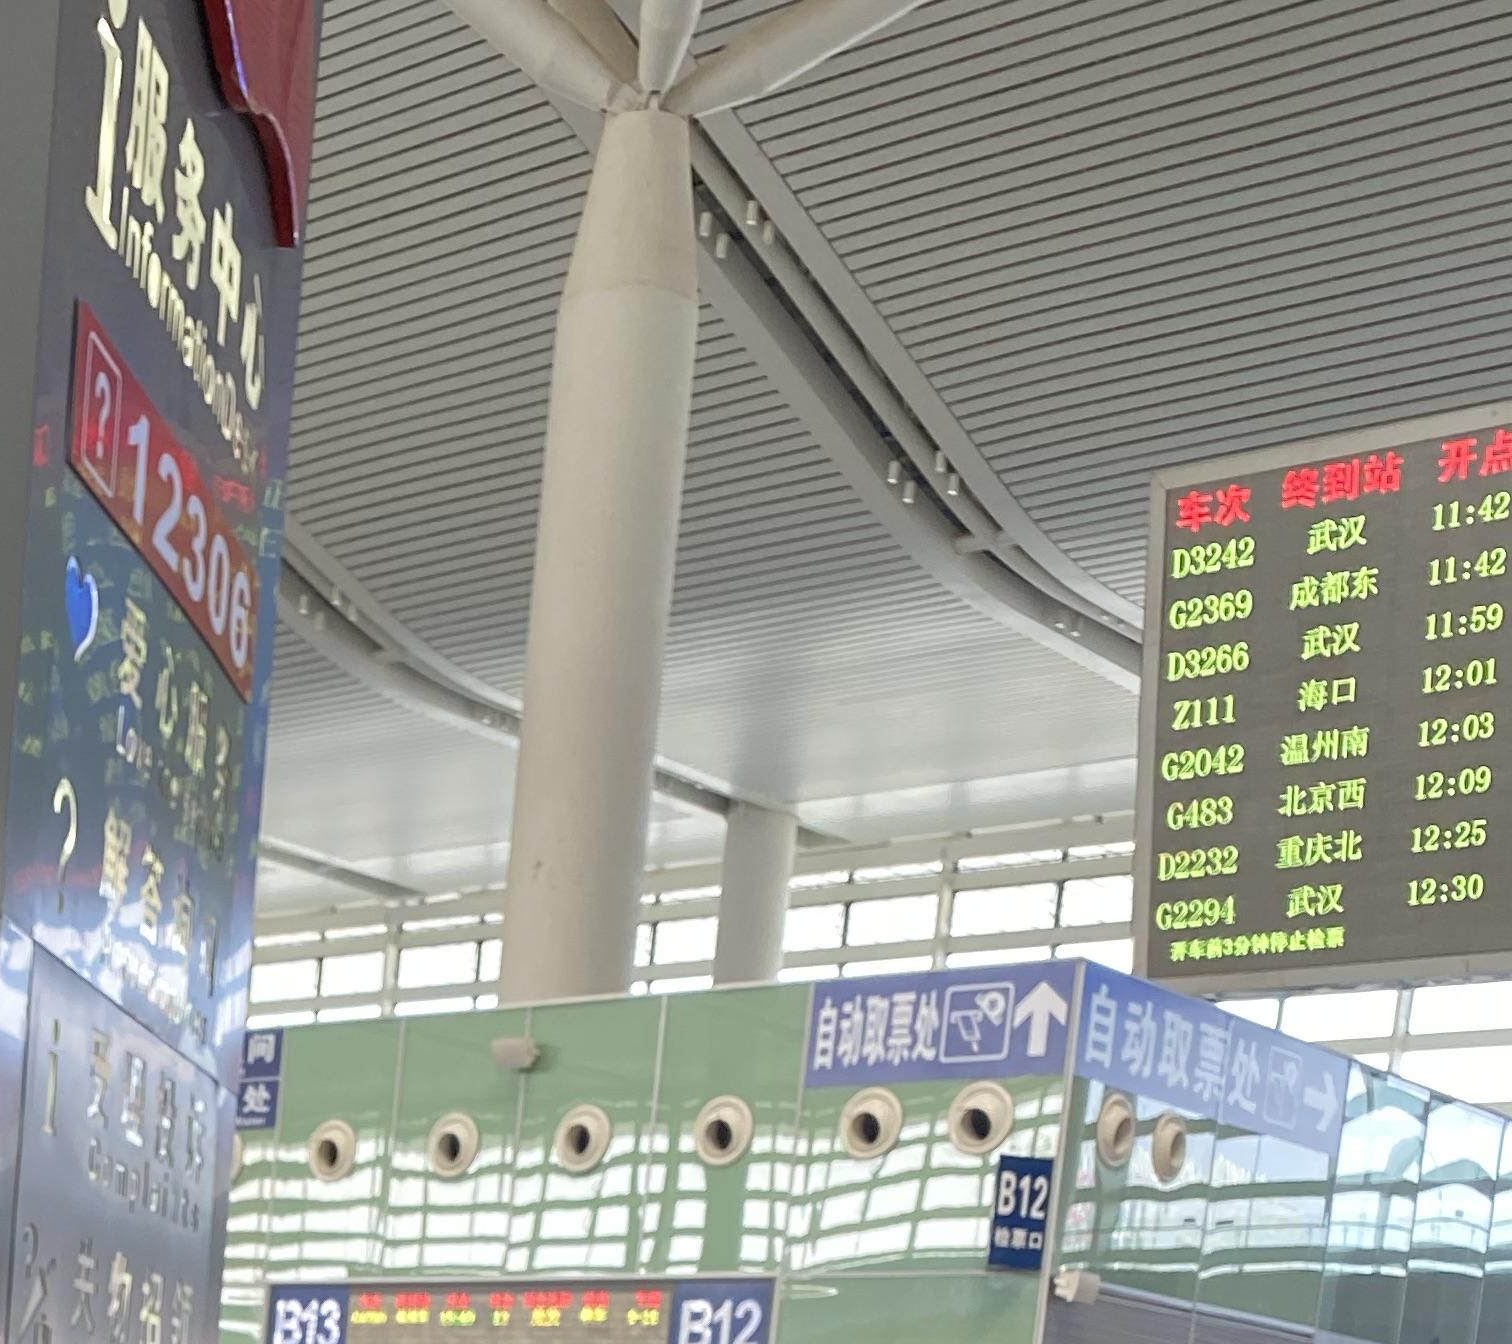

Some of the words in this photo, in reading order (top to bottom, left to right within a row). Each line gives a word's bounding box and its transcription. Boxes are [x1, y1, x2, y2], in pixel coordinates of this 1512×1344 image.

[124, 15, 265, 411] 服务中心
[1177, 483, 1252, 533] 车次
[1281, 451, 1405, 509] 终到站
[1438, 428, 1512, 483] 开点
[128, 414, 252, 669] 12306
[1172, 536, 1256, 578] D3242
[1307, 514, 1368, 555] 武汉
[1433, 491, 1511, 531] 11:42
[1169, 589, 1254, 630] G2369
[1290, 566, 1380, 611] 成都东
[1429, 547, 1507, 586] 11:42
[1166, 641, 1250, 682] D3266
[1300, 622, 1361, 660] 武汉
[1425, 603, 1504, 640] 11:59
[1171, 694, 1236, 731] Z111
[1297, 677, 1356, 712] 海口
[1422, 657, 1497, 695] 12:01
[1161, 744, 1245, 782] G2042
[1280, 725, 1370, 766] 温州南
[1418, 711, 1495, 748] 12:03
[1166, 796, 1234, 831] G483
[1276, 778, 1367, 817] 北京西
[1414, 766, 1492, 801] 12:09
[1157, 845, 1240, 881] D2232
[1275, 830, 1363, 869] 重庆北
[1410, 819, 1488, 853] 12:25
[1155, 896, 1236, 931] G2294
[1286, 884, 1345, 918] 武汉
[1407, 874, 1485, 906] 12:30
[813, 985, 939, 1071] 自动取票处
[1085, 984, 1263, 1114] 自动取票处
[997, 1169, 1049, 1220] B12
